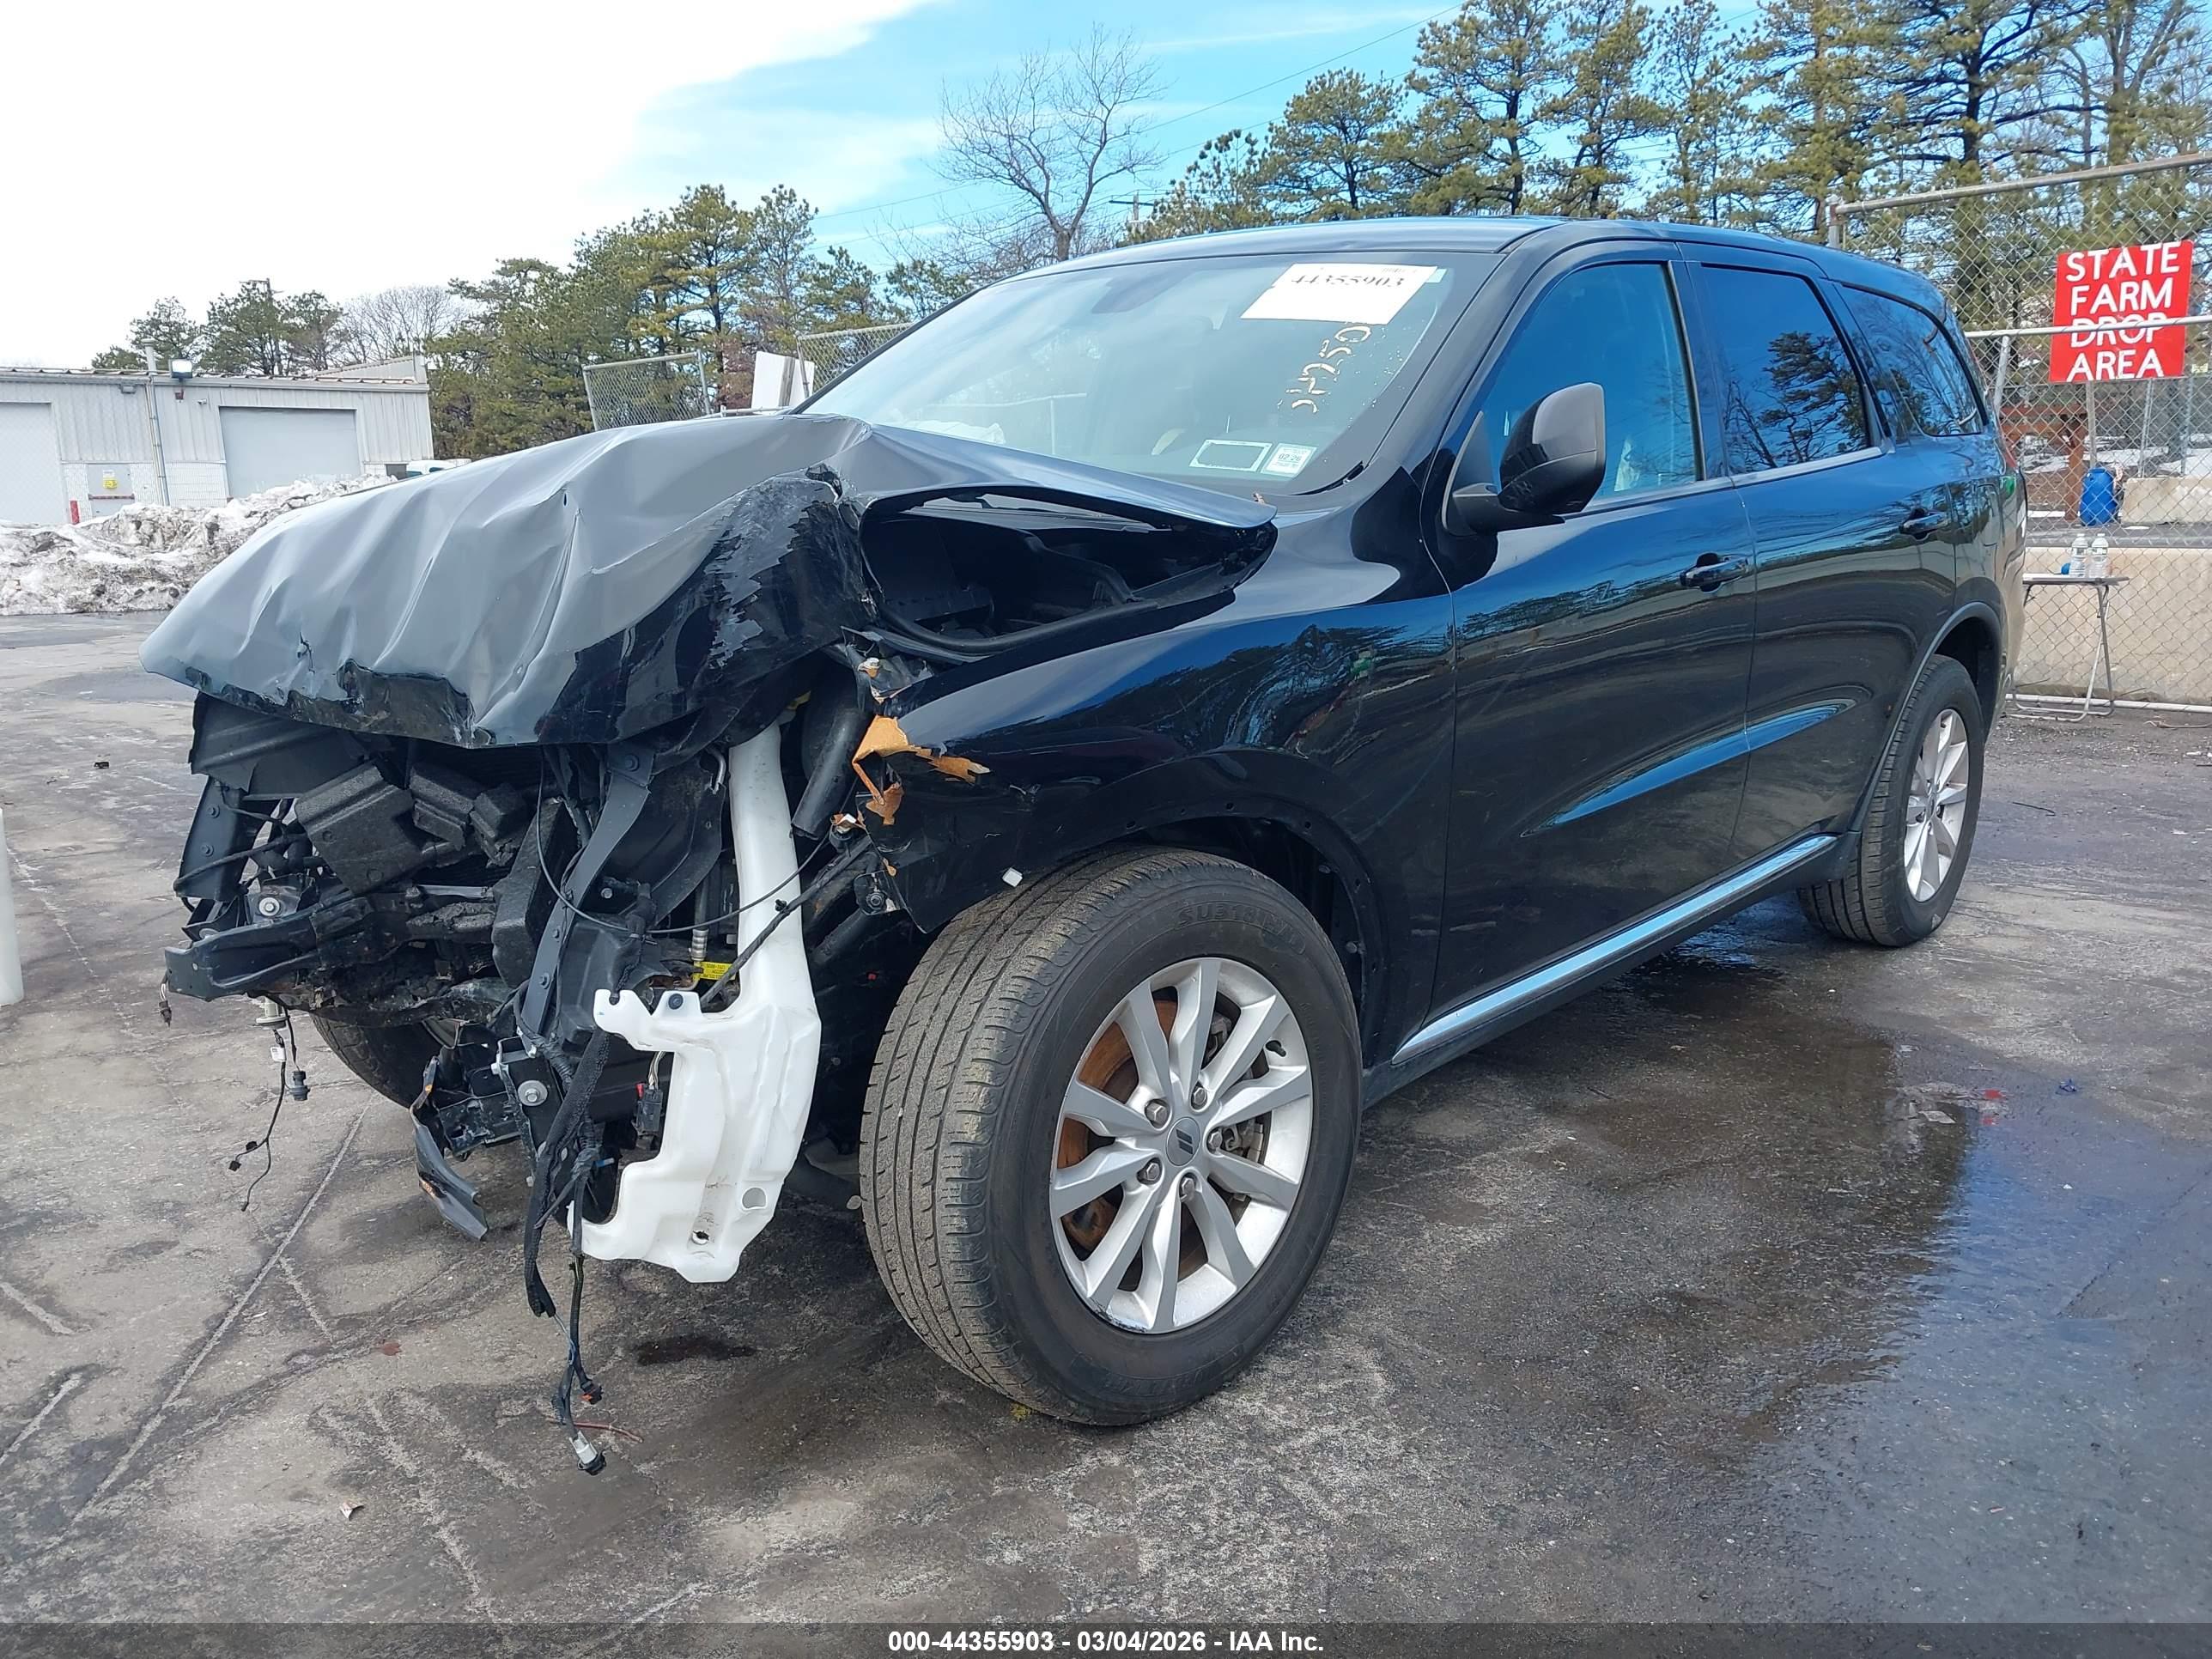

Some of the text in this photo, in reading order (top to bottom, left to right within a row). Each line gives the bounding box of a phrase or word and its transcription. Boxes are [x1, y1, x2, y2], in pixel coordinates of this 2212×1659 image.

[2065, 241, 2182, 282] STATE
[2070, 277, 2173, 316] FARM
[2070, 312, 2168, 349] DROP
[2066, 348, 2165, 382] AREA
